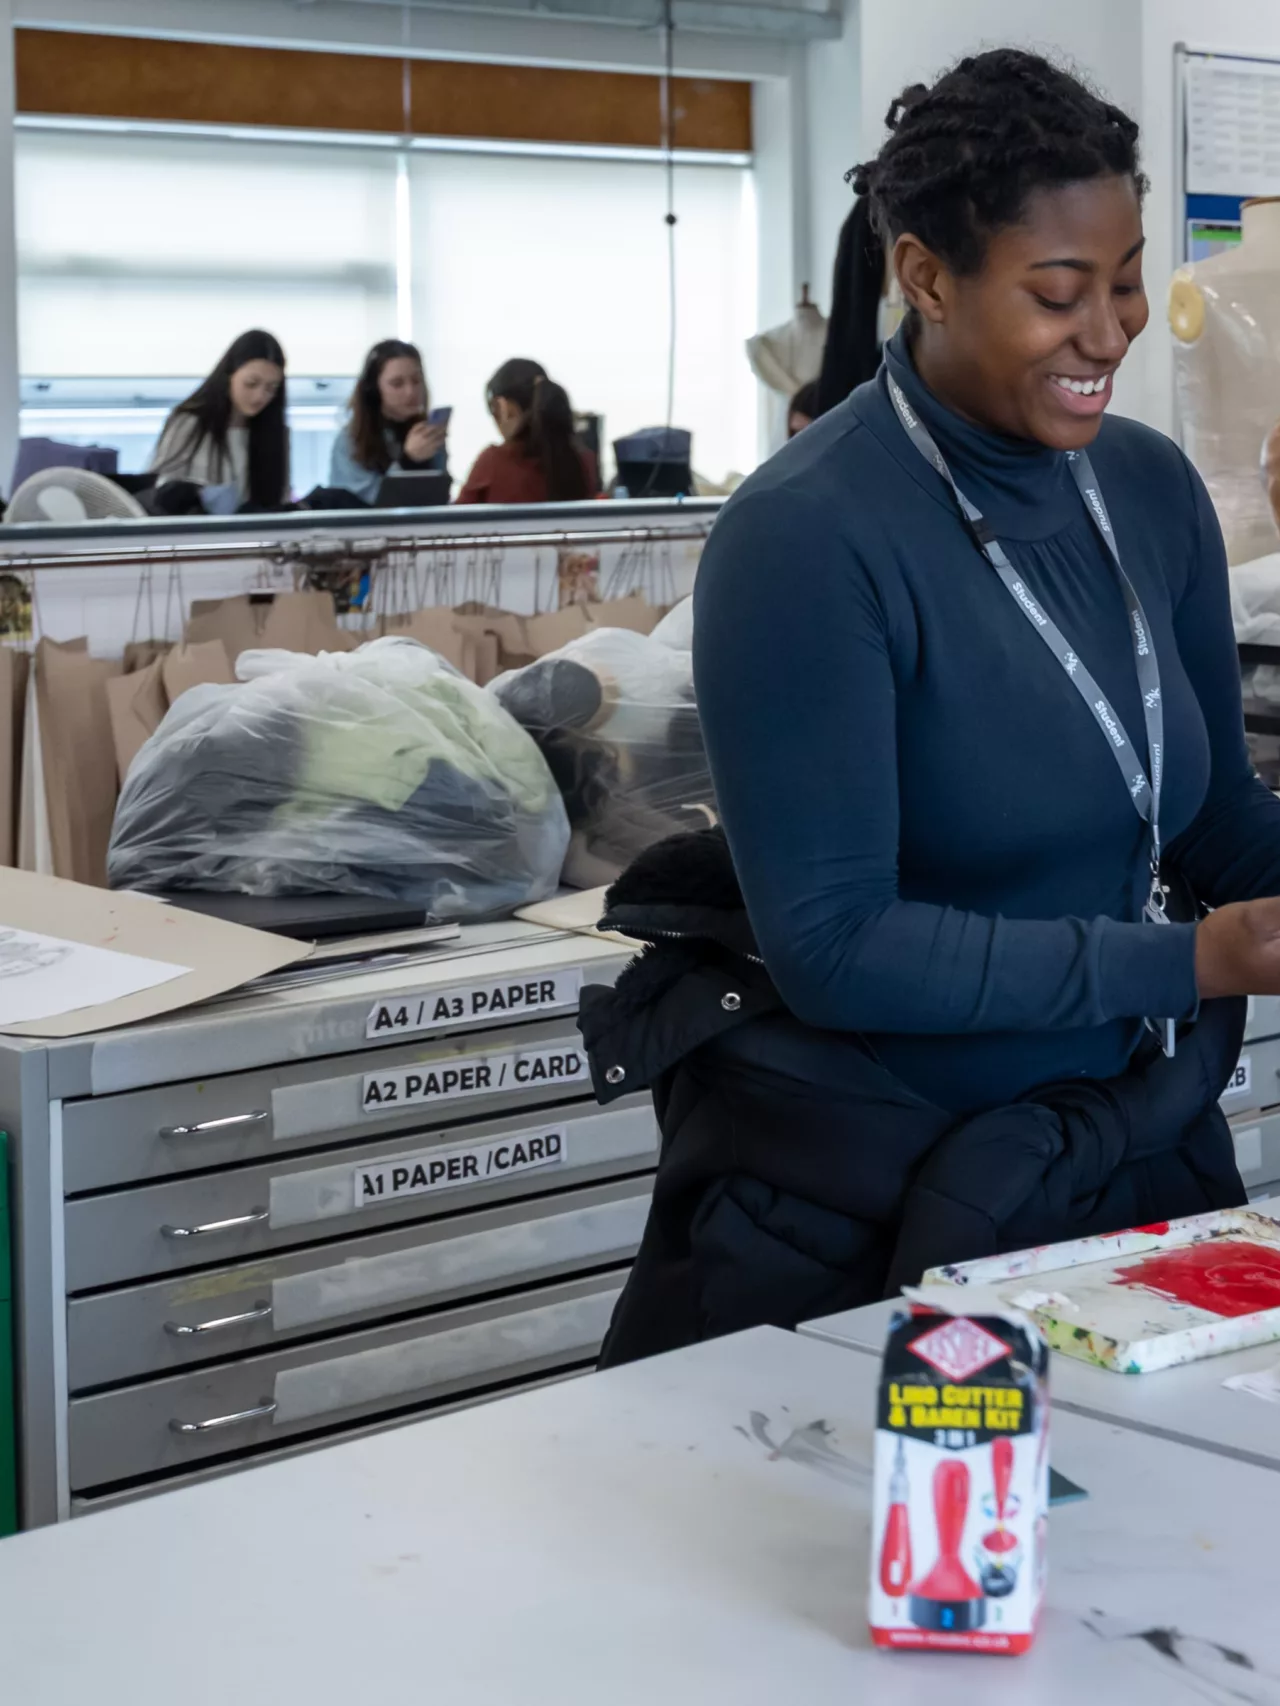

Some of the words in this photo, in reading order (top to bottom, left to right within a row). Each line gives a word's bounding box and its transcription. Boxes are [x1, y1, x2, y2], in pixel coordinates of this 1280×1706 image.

[893, 386, 917, 428] Student
[1085, 488, 1110, 532] Student
[1012, 581, 1047, 626] Student
[1131, 609, 1149, 656] Student
[1095, 700, 1125, 747] Student
[374, 1005, 409, 1030] A4
[416, 1001, 424, 1025] /
[432, 997, 464, 1021] A3
[471, 980, 555, 1014] PAPER
[364, 1081, 398, 1104] A2
[405, 1065, 491, 1098] PAPER
[498, 1063, 507, 1086] /
[514, 1053, 581, 1082] CARD
[362, 1173, 384, 1196] A1
[392, 1155, 479, 1191] PAPER
[889, 1383, 939, 1405] LINO
[941, 1384, 1024, 1408] CUTTER
[985, 1408, 1021, 1430] KIT
